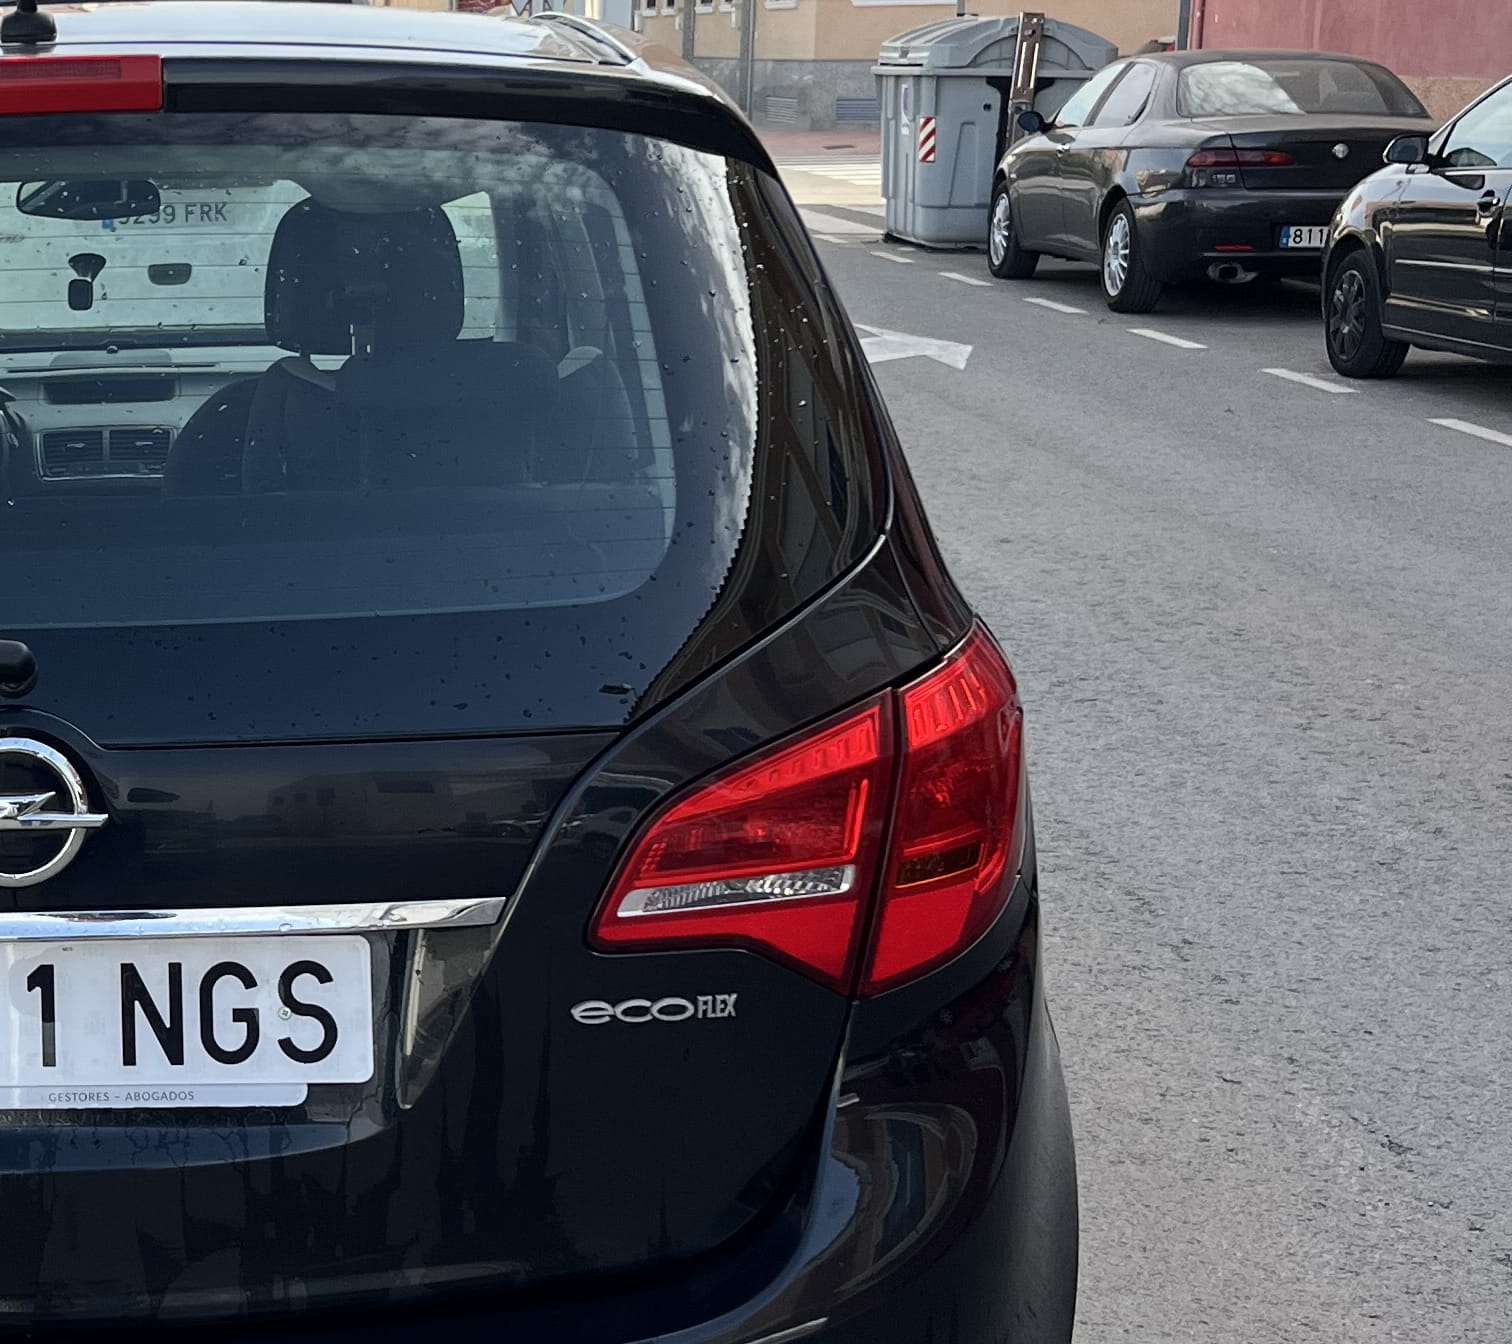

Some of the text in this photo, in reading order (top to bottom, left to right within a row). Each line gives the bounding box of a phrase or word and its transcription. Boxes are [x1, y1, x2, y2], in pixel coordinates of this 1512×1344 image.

[185, 202, 227, 223] FRK
[120, 959, 337, 1067] NGS
[48, 1092, 110, 1102] GESTORES
[124, 1091, 194, 1101] ABOGADOS
